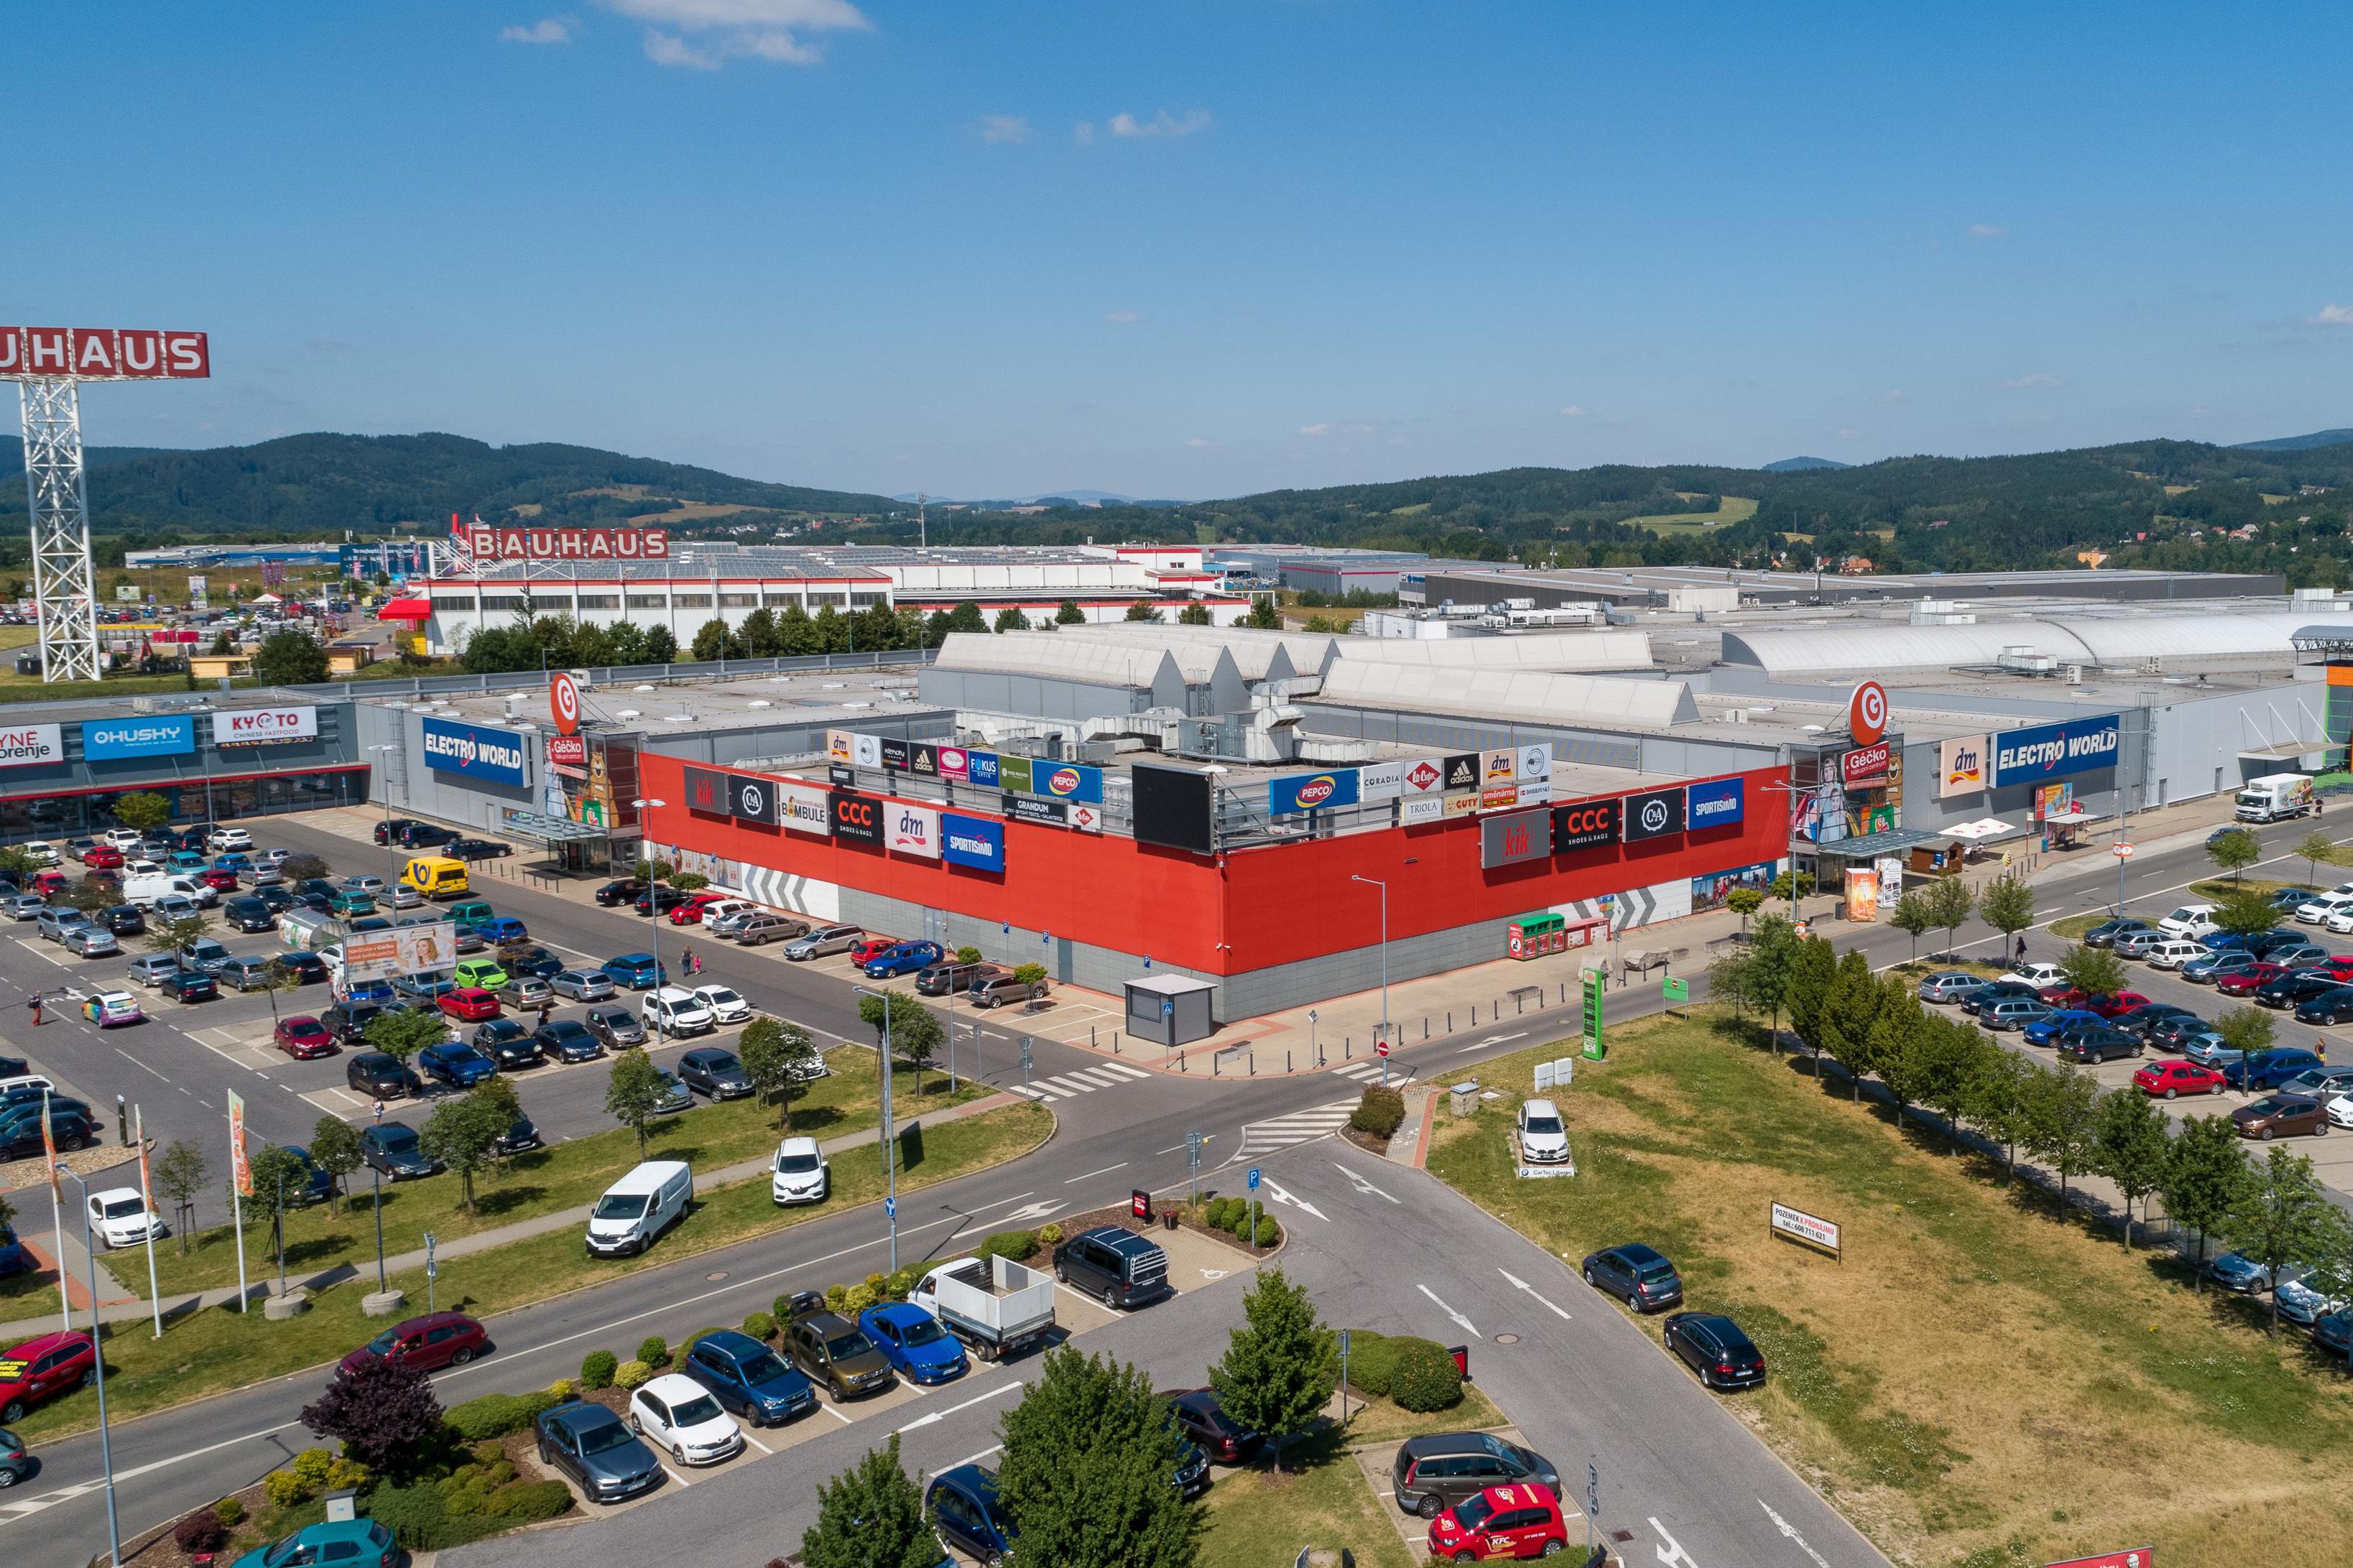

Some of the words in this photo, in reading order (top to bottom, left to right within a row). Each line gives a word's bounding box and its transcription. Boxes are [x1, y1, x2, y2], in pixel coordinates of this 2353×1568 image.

[475, 532, 666, 555] BAUHAUS
[833, 736, 846, 750] dm
[0, 743, 50, 759] orenje
[425, 733, 476, 761] ELECTRO
[479, 742, 522, 769] WORLD
[1999, 740, 2065, 770] ELECTRO
[2068, 732, 2118, 757] WORLD
[915, 762, 933, 771] adidas
[971, 759, 997, 772] FOKUS
[1492, 755, 1509, 771] dm
[1850, 749, 1887, 769] Géčko
[1955, 747, 1977, 771] dm
[1053, 776, 1076, 787] PEPCO
[1364, 775, 1400, 787] CORADIA
[1450, 774, 1474, 784] adidas
[1302, 784, 1332, 799] PEPCO
[746, 792, 759, 807] C&A
[1017, 800, 1049, 813] GRANDUM
[1456, 797, 1478, 809] GUTY
[838, 800, 872, 826] CCC
[1410, 802, 1437, 814] TRIOLA
[1646, 808, 1663, 822] C&A
[900, 810, 923, 836] dm
[1568, 807, 1609, 834] CCC
[1505, 821, 1530, 855] kik
[1568, 835, 1586, 845] SHOES
[1250, 1172, 1257, 1183] P
[1775, 1207, 1799, 1222] POZEMEK
